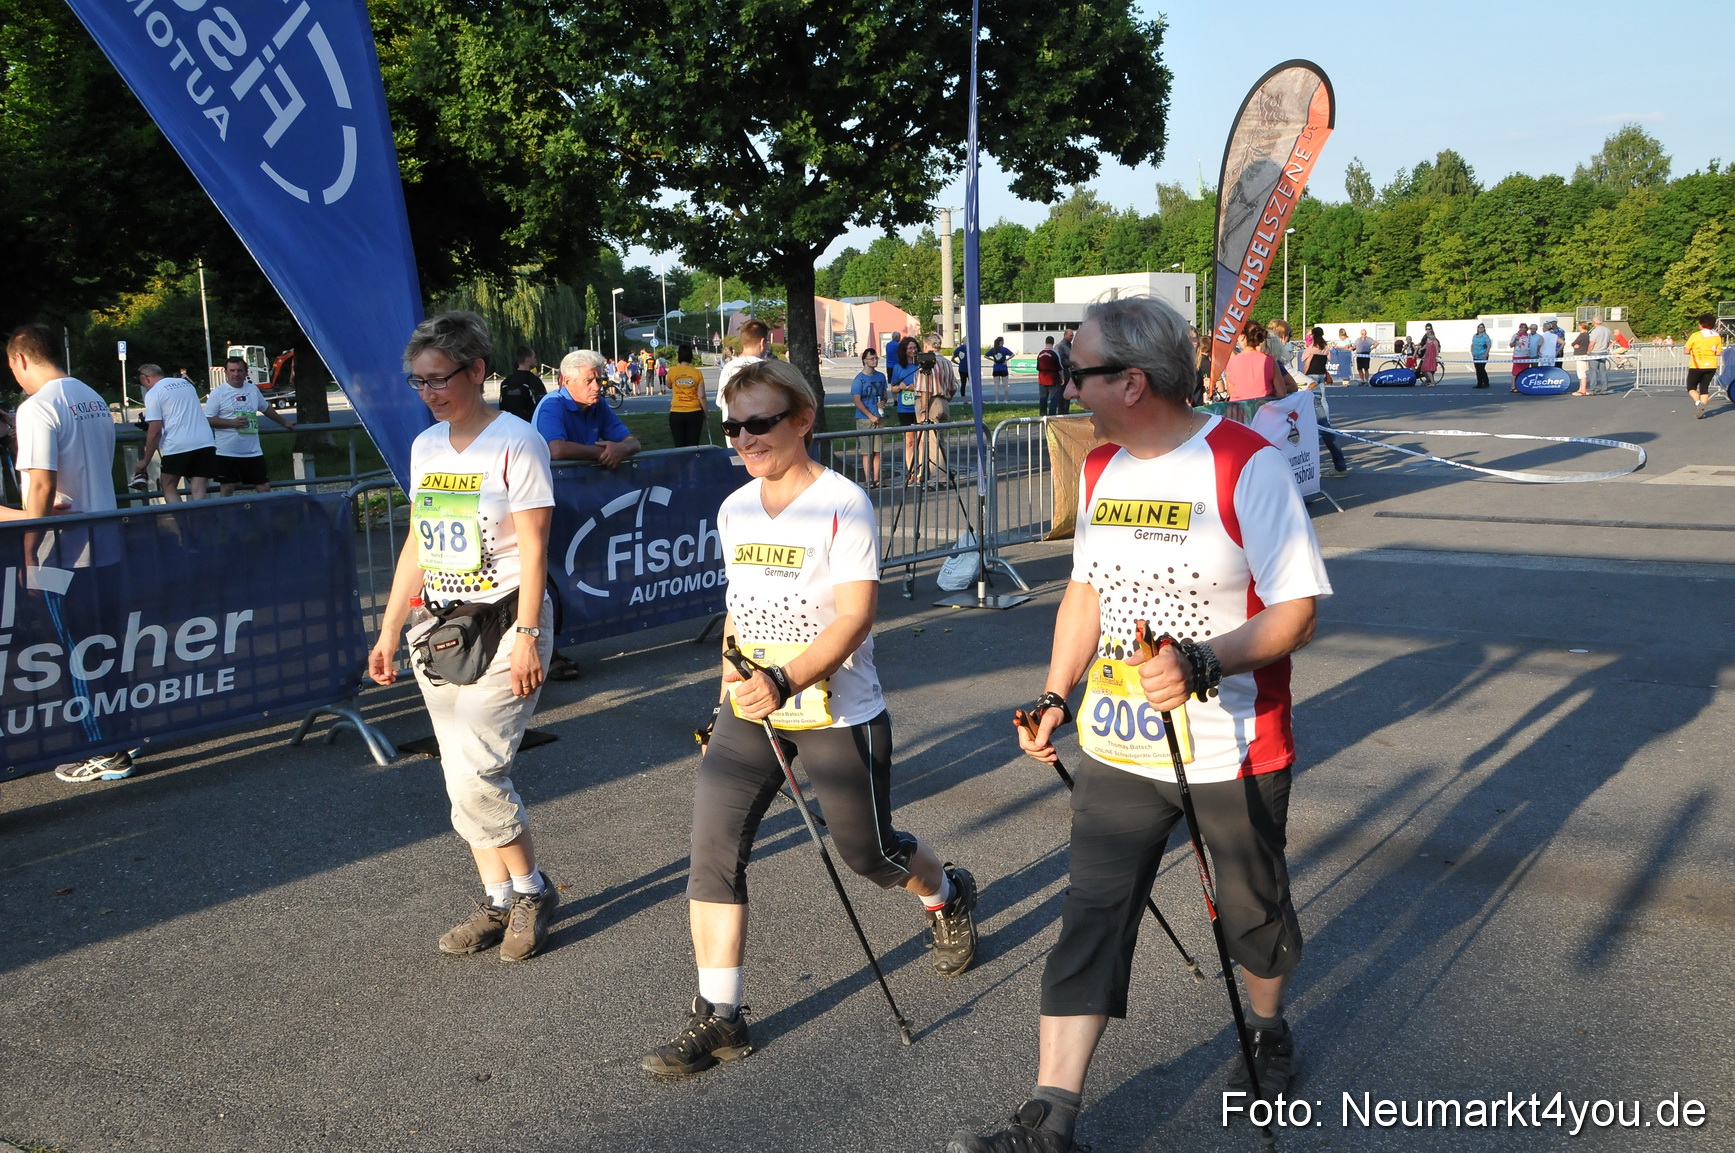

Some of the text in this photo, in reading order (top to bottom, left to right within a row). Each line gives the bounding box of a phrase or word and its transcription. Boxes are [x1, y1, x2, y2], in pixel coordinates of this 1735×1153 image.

[1529, 378, 1565, 386] Fischer
[421, 475, 478, 489] ONLINE
[1095, 502, 1180, 526] ONLINE
[420, 520, 467, 552] 918
[1134, 529, 1188, 546] Germany
[735, 546, 797, 565] ONLINE
[764, 567, 800, 580] Germany
[628, 567, 730, 606] AUTOMOB
[0, 666, 236, 738] UTOMOBILE
[1091, 696, 1166, 741] 906
[1094, 746, 1114, 755] ONLINE
[1107, 740, 1129, 750] Thomas
